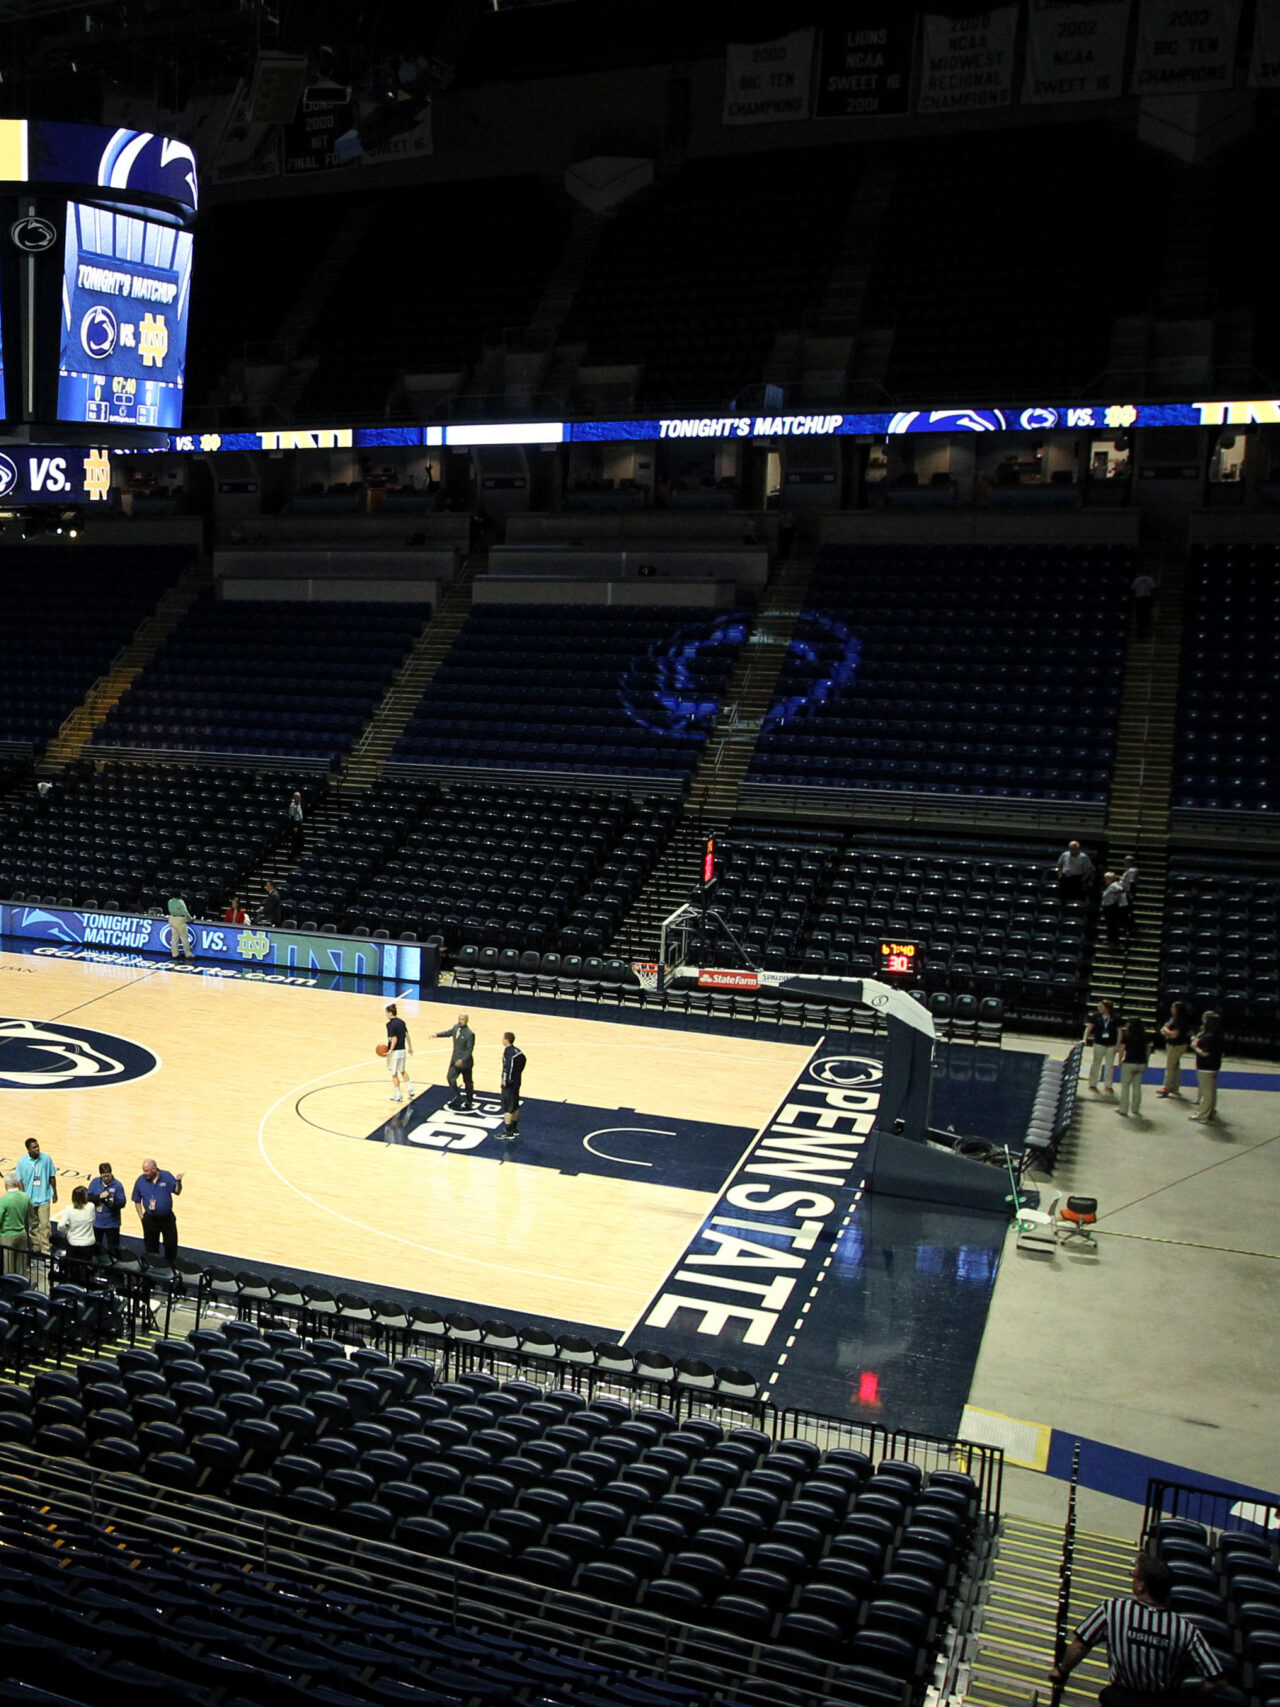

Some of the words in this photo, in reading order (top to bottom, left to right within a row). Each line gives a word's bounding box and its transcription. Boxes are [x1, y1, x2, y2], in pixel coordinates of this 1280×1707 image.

[847, 28, 889, 47] LIONS
[1190, 38, 1219, 54] TEN
[752, 47, 787, 63] 2000
[827, 74, 880, 93] SWEET
[1138, 64, 1228, 85] CHAMPIONS
[729, 98, 802, 117] CHAMPIONS
[77, 264, 131, 297] TONIGHT'S
[131, 275, 178, 304] MATCHUP
[112, 376, 137, 395] 67:40
[659, 418, 750, 438] TONIGHT'S
[753, 414, 843, 435] MATCHUP
[1066, 408, 1096, 428] VS.
[175, 435, 194, 451] VS.
[28, 457, 71, 491] VS.
[82, 912, 153, 935] TONIGHT'S
[83, 926, 150, 949] MATCHUP
[202, 931, 228, 951] VS.
[882, 943, 915, 957] 67:40
[33, 946, 320, 987] GoPSUsports.com
[890, 955, 908, 972] 30
[744, 1083, 880, 1187] PENN
[644, 1183, 836, 1346] STATE
